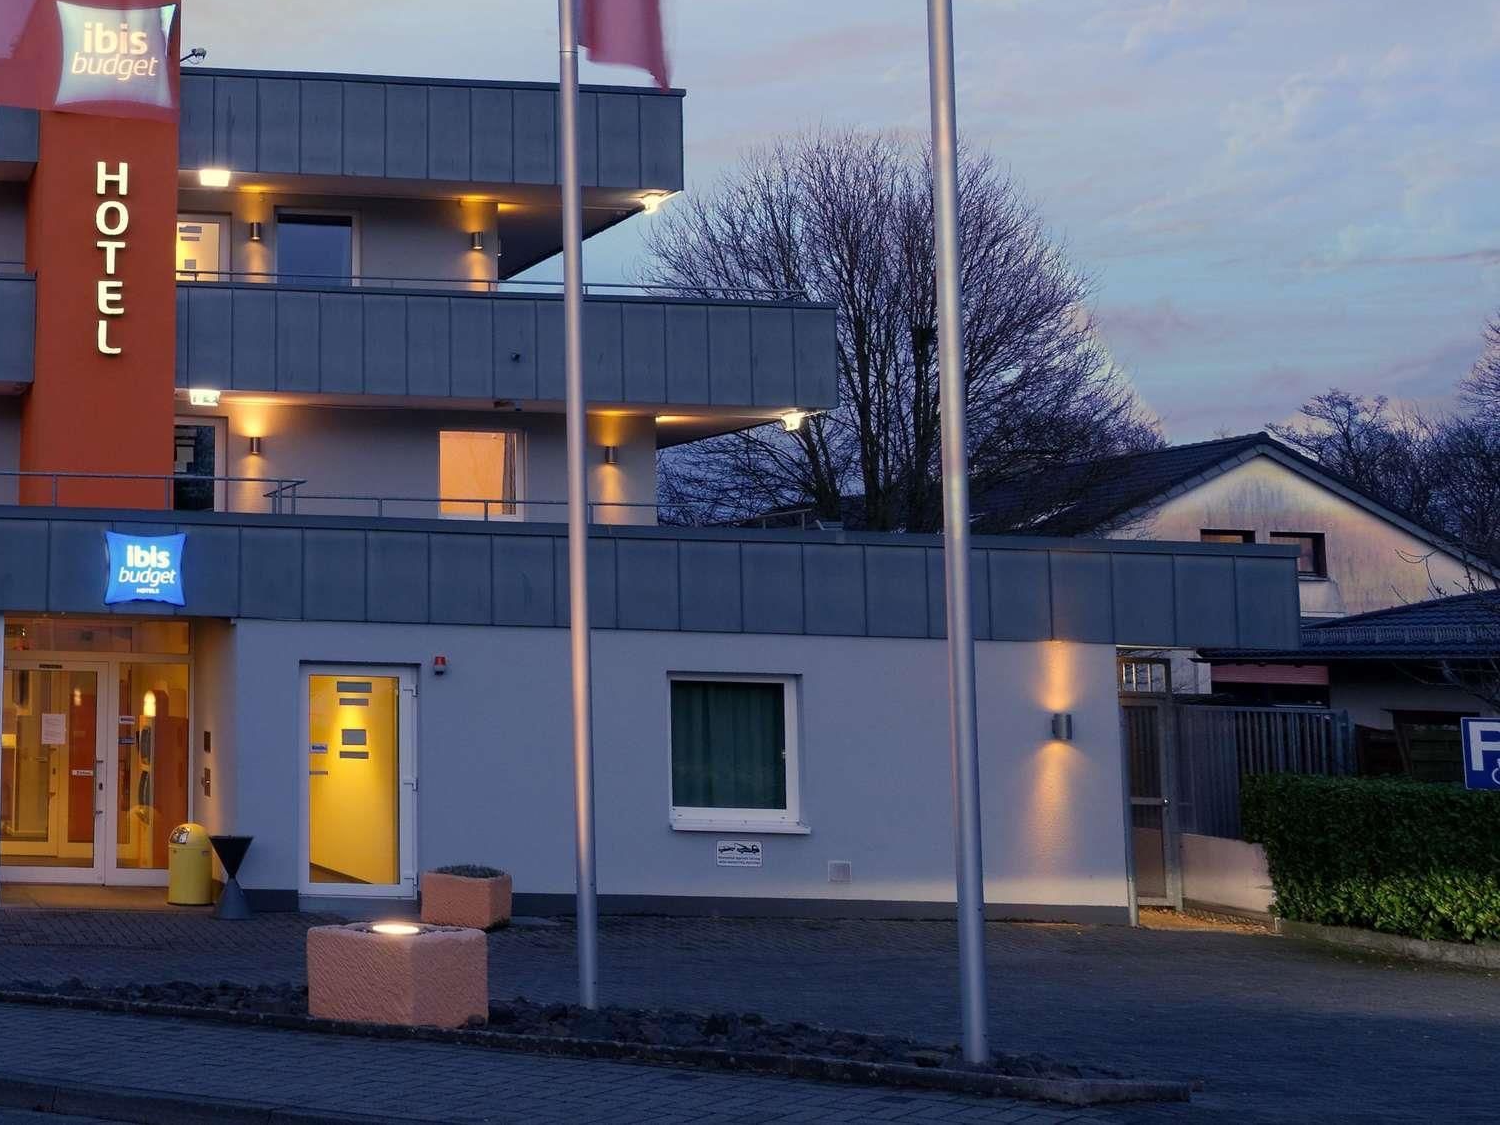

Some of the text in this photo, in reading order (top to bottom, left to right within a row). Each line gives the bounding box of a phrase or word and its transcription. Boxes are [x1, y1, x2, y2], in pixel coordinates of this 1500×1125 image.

[83, 22, 149, 55] ibis
[71, 51, 158, 83] budget
[95, 161, 130, 355] HOTEL
[126, 544, 171, 569] ibis
[118, 566, 177, 588] budget
